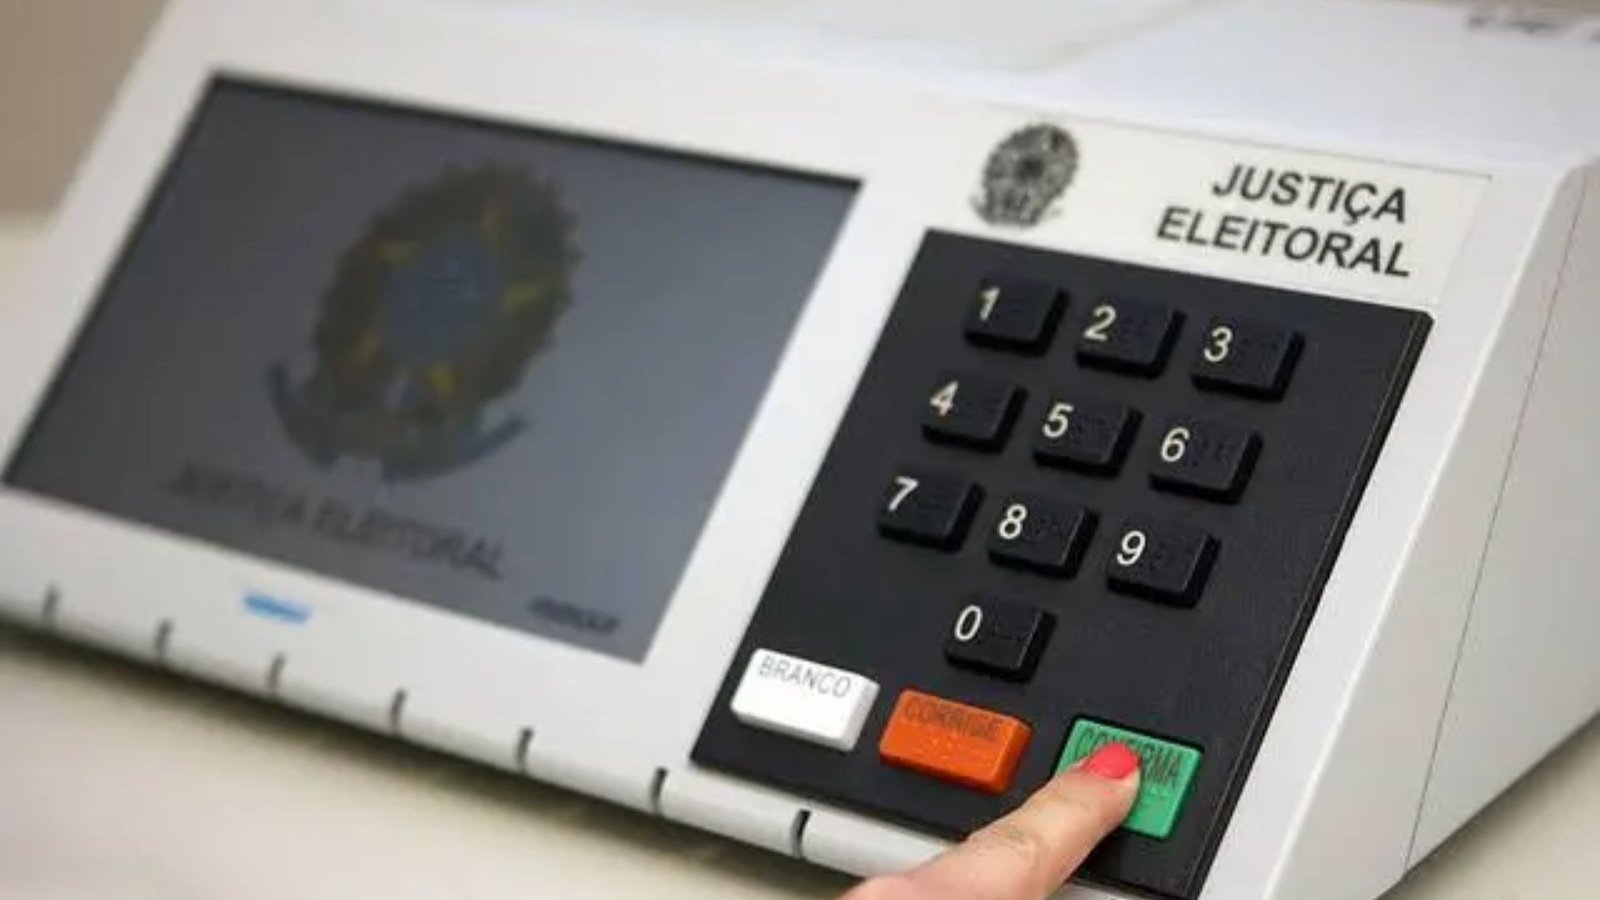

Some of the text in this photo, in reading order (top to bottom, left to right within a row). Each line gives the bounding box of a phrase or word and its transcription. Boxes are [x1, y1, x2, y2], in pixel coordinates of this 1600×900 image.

[1212, 165, 1405, 226] JUSTIÇA
[1156, 206, 1411, 278] ELEITORAL
[979, 286, 1233, 362] 1 2 3
[930, 381, 1190, 463] 4 5 6
[889, 476, 1146, 567] 7 8 9
[953, 604, 983, 642] 0
[759, 655, 851, 698] BRANCO
[904, 696, 1001, 742] CORRIGE
[1073, 727, 1183, 786] CORMA
